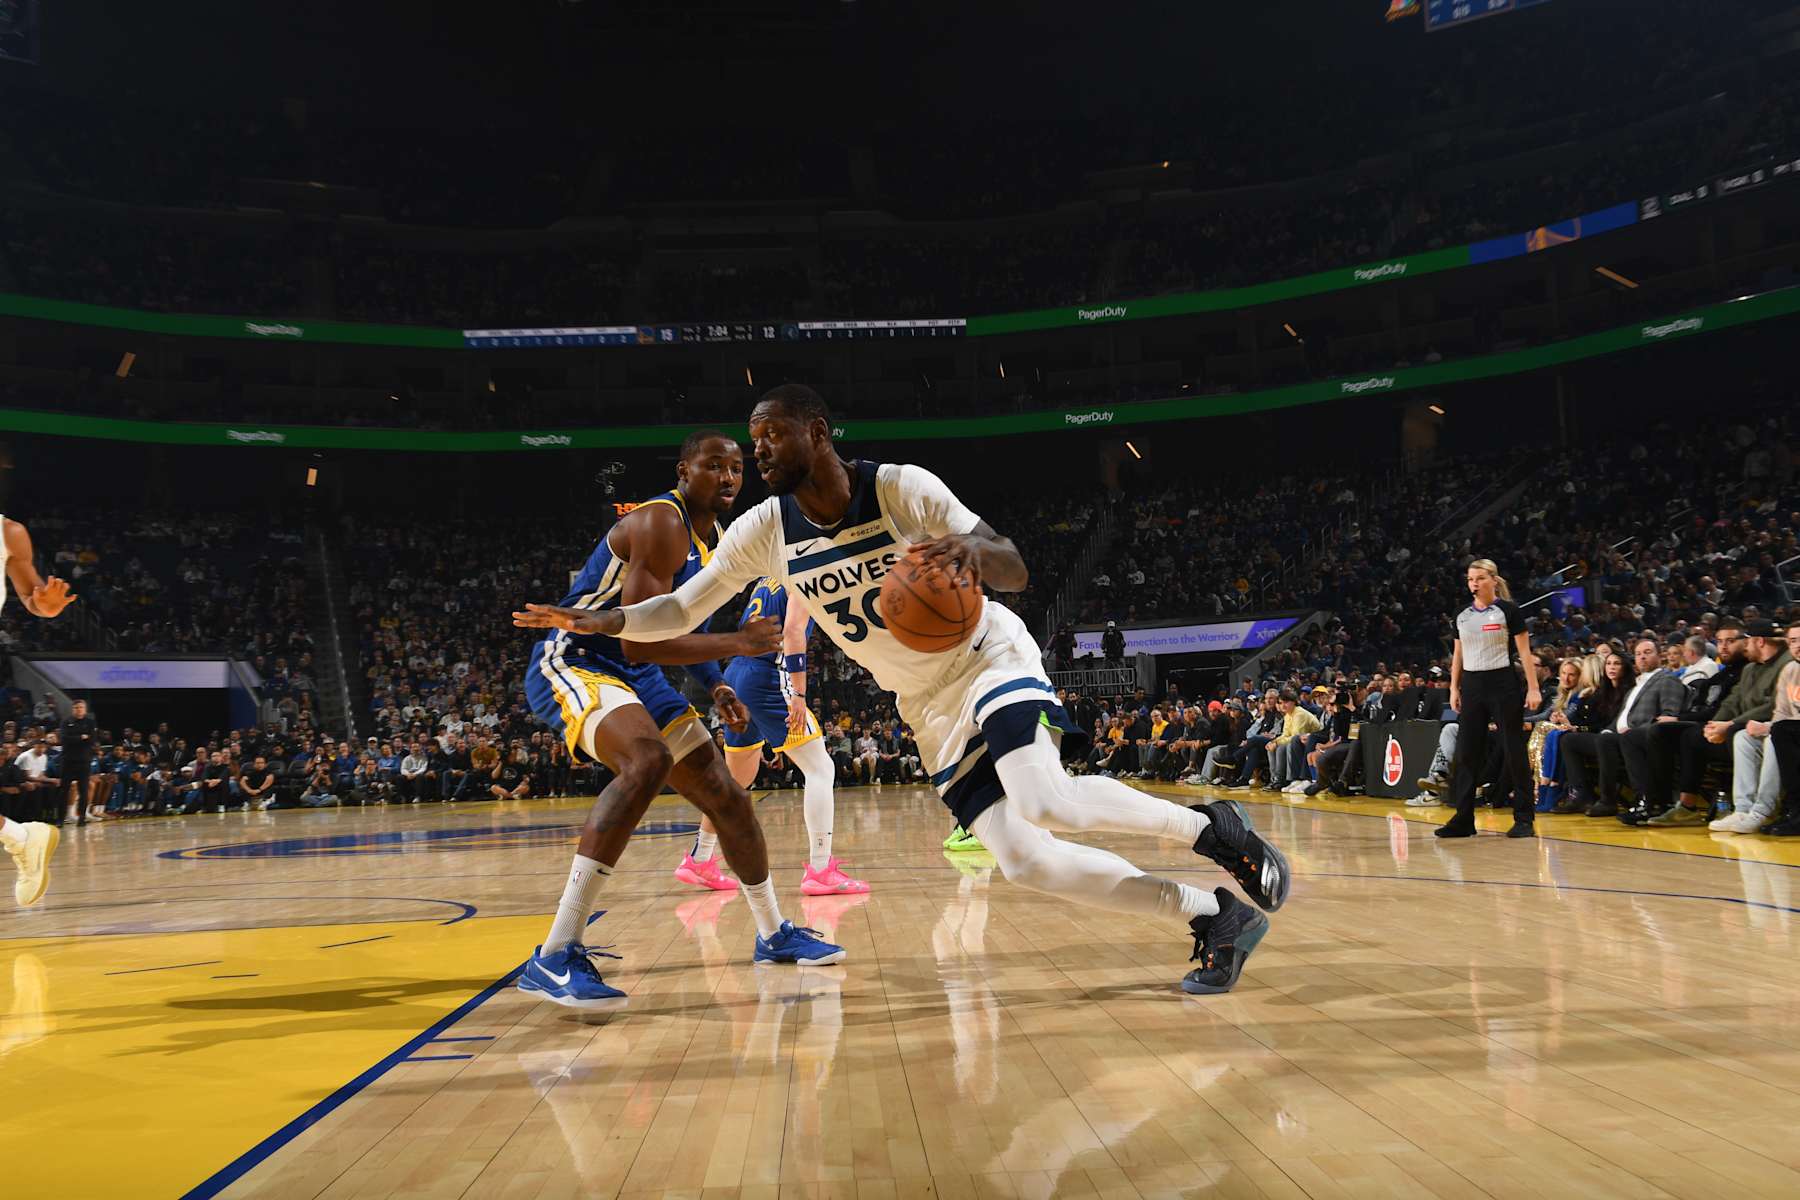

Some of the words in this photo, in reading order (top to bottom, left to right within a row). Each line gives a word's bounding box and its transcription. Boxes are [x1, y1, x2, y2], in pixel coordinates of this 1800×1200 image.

[1079, 306, 1127, 320] PagerDuty
[1065, 411, 1114, 425] PagerDuty
[796, 553, 897, 600] WOLVES
[1181, 633, 1196, 643] the
[1198, 631, 1240, 642] Warriors
